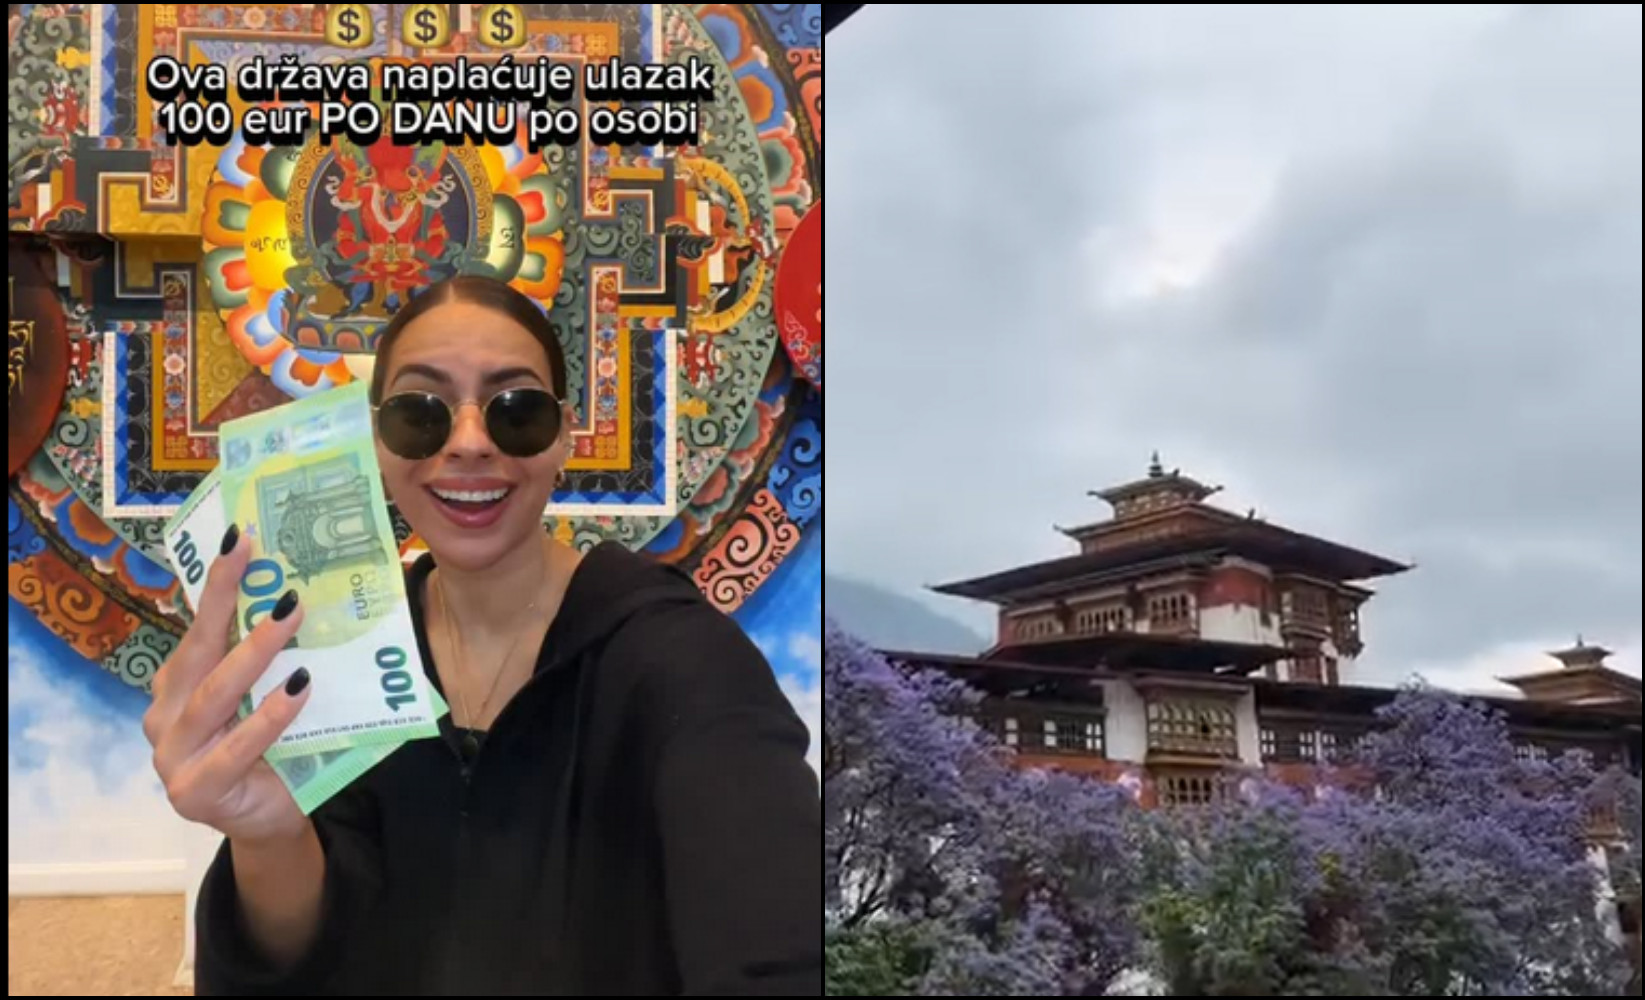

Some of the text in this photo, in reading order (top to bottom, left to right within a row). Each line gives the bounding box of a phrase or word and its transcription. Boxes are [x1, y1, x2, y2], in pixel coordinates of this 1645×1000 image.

[172, 530, 205, 585] 100
[350, 573, 370, 621] EURO
[375, 646, 418, 712] 100
